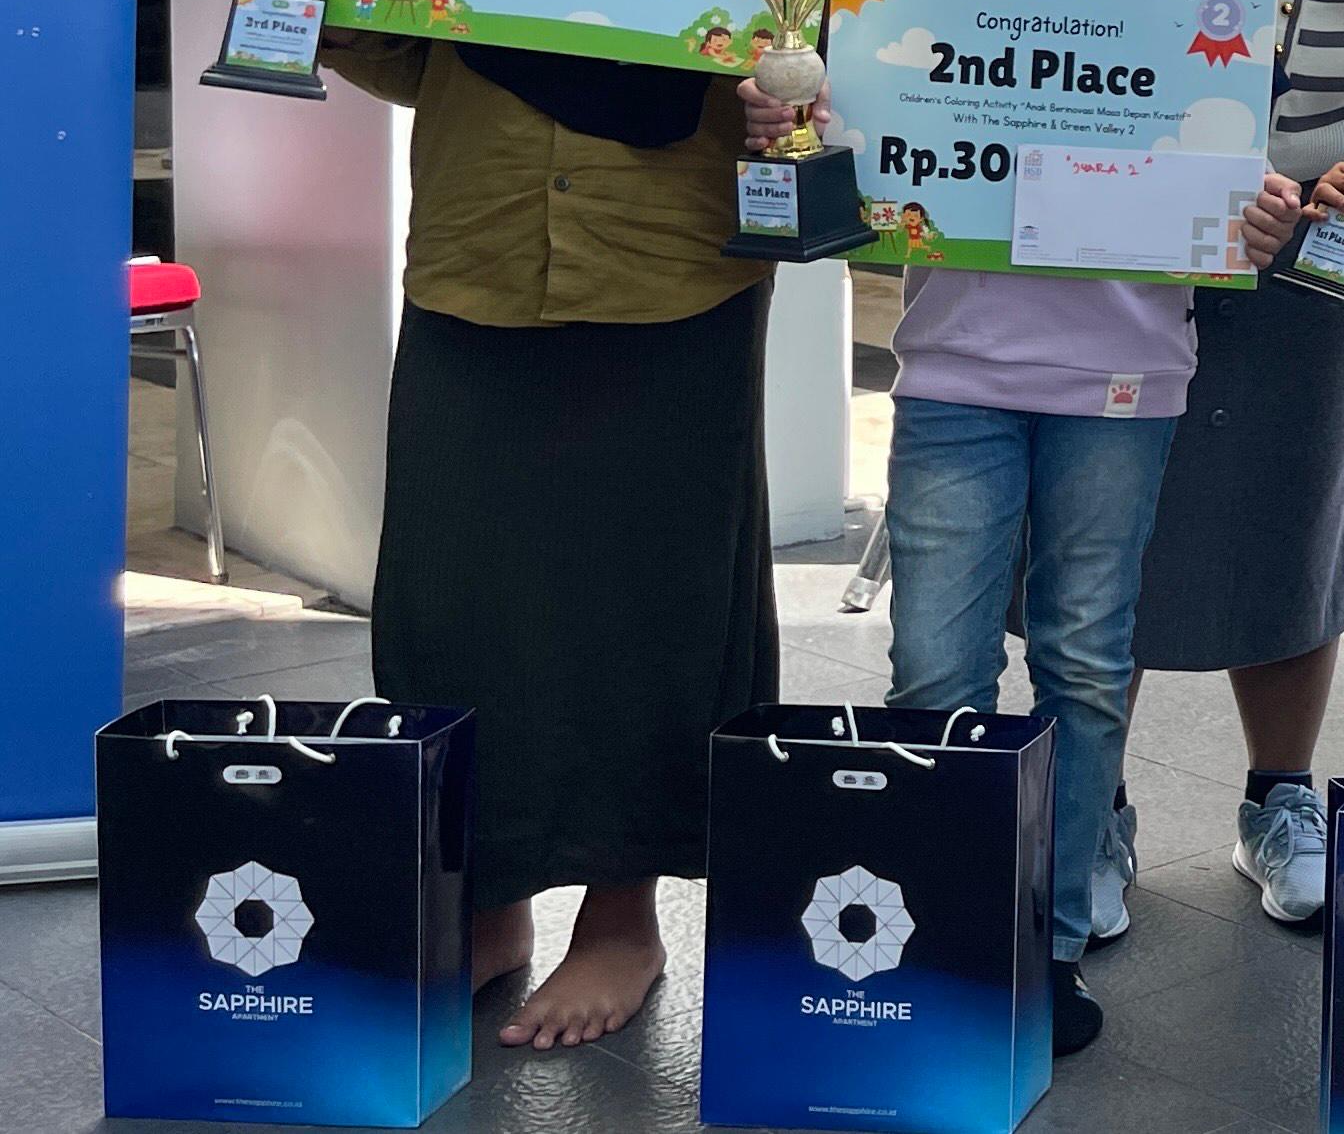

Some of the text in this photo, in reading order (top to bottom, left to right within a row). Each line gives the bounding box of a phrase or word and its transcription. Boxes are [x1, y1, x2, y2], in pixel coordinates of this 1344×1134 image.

[1211, 2, 1231, 27] 2
[272, 20, 308, 35] Place
[976, 11, 1124, 41] Congratulation!
[929, 41, 1157, 97] 2nd Place
[899, 92, 942, 106] Children's
[944, 95, 981, 110] Coloring
[982, 98, 1018, 112] Activity
[952, 112, 1136, 137] With The Sapphire & Green Valley 2
[880, 135, 1018, 187] Rp.30
[745, 185, 791, 199] 2nd Place
[1316, 227, 1329, 240] 1st
[245, 984, 265, 995] THE
[846, 989, 865, 999] THE
[199, 992, 314, 1014] SAPPHIRE
[800, 995, 912, 1021] SAPPHIRE
[231, 1012, 279, 1022] APARTMENT
[832, 1017, 878, 1027] APARTMENT
